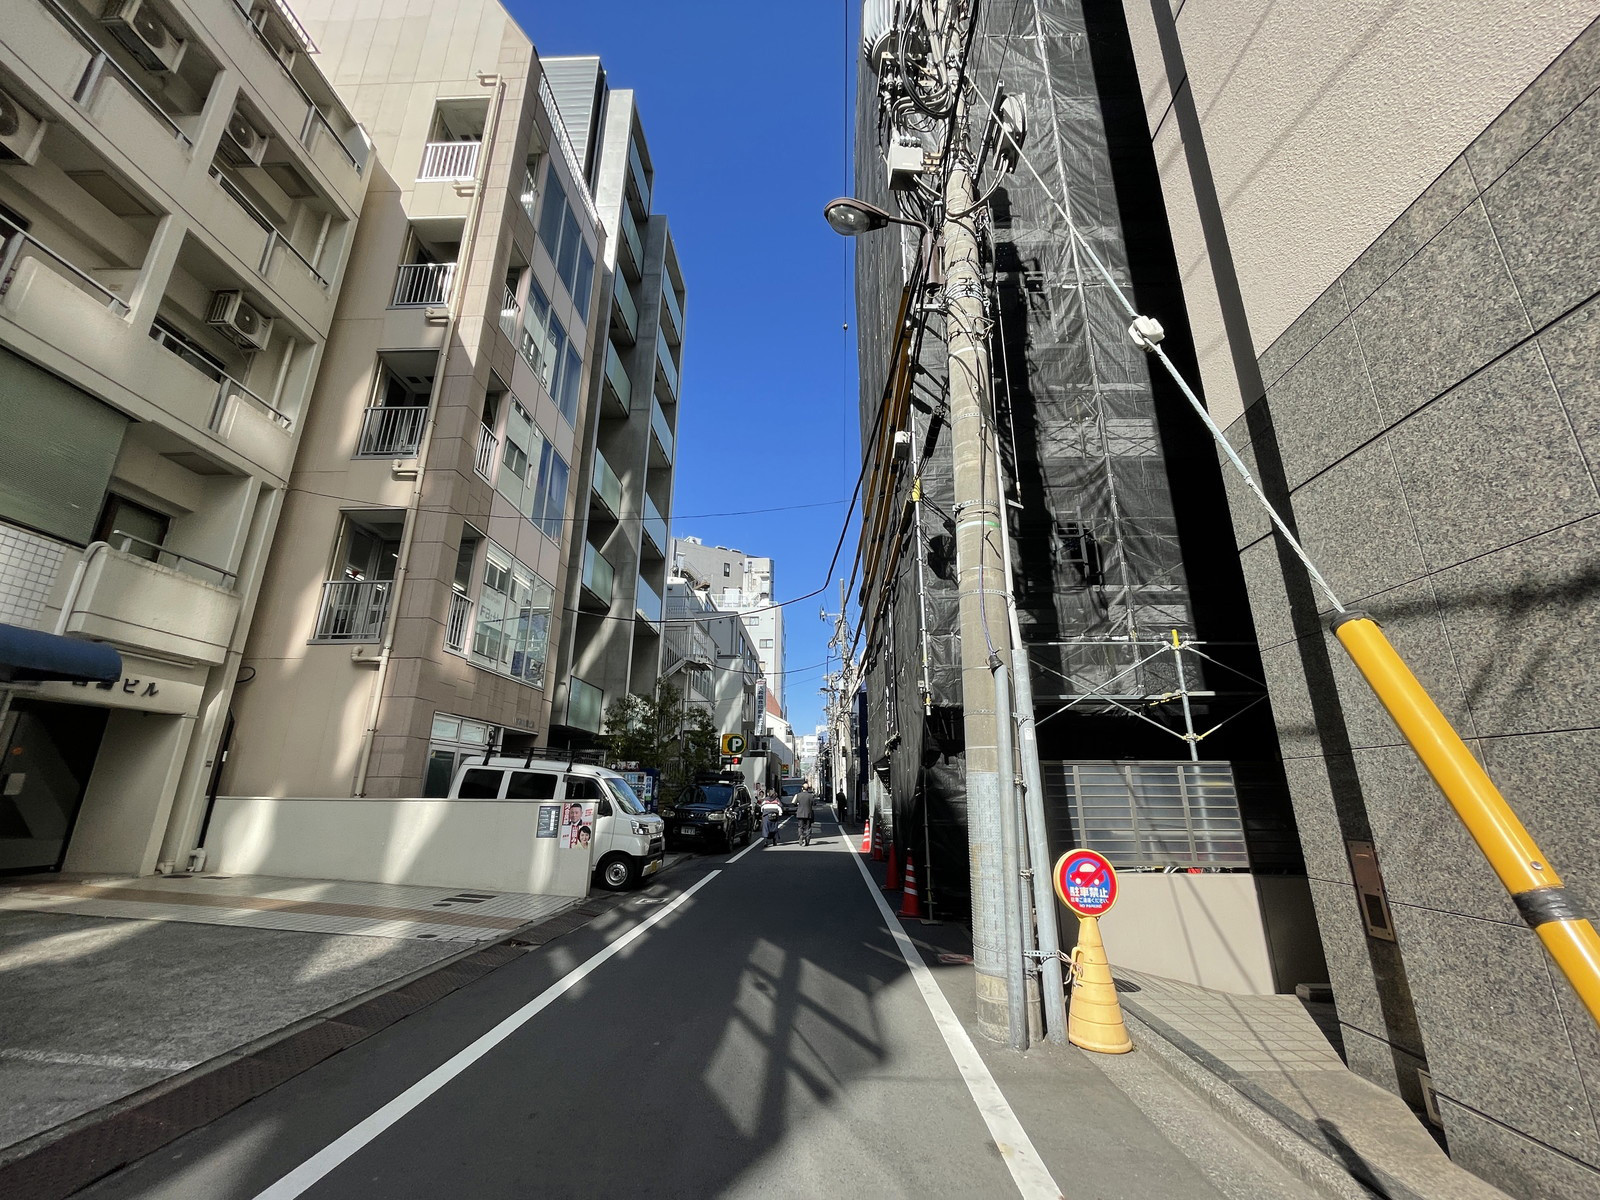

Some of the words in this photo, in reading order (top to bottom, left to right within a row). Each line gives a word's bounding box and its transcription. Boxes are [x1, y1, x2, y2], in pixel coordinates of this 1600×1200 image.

[732, 738, 742, 752] P
[1070, 886, 1109, 897] 駐車禁止
